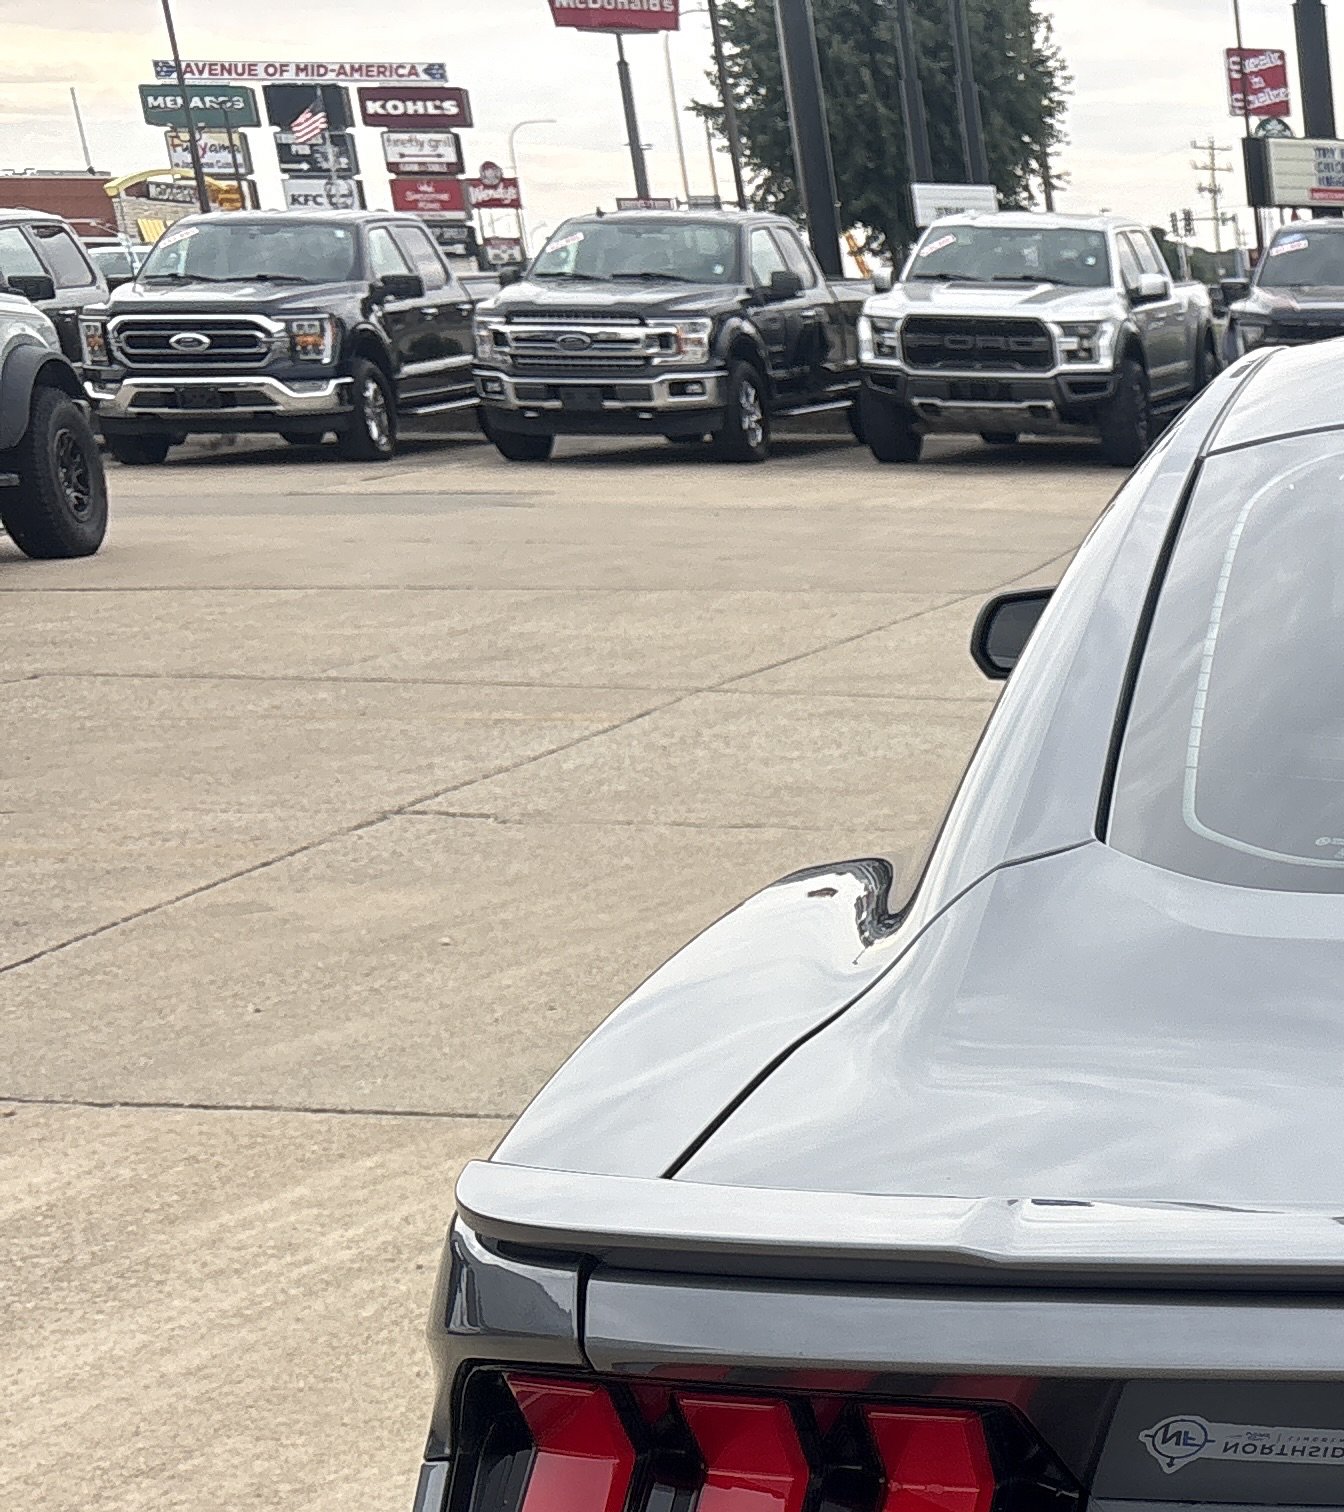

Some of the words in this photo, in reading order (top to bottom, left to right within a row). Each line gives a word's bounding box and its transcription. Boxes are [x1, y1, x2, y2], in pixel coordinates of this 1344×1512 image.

[554, 0, 675, 12] McDonalds
[183, 63, 258, 77] AVENUE
[263, 63, 290, 78] OF
[295, 63, 419, 78] MID-AMERICA
[365, 100, 459, 115] KOHL'S
[169, 134, 241, 159] Fuyama
[291, 194, 324, 206] KFC
